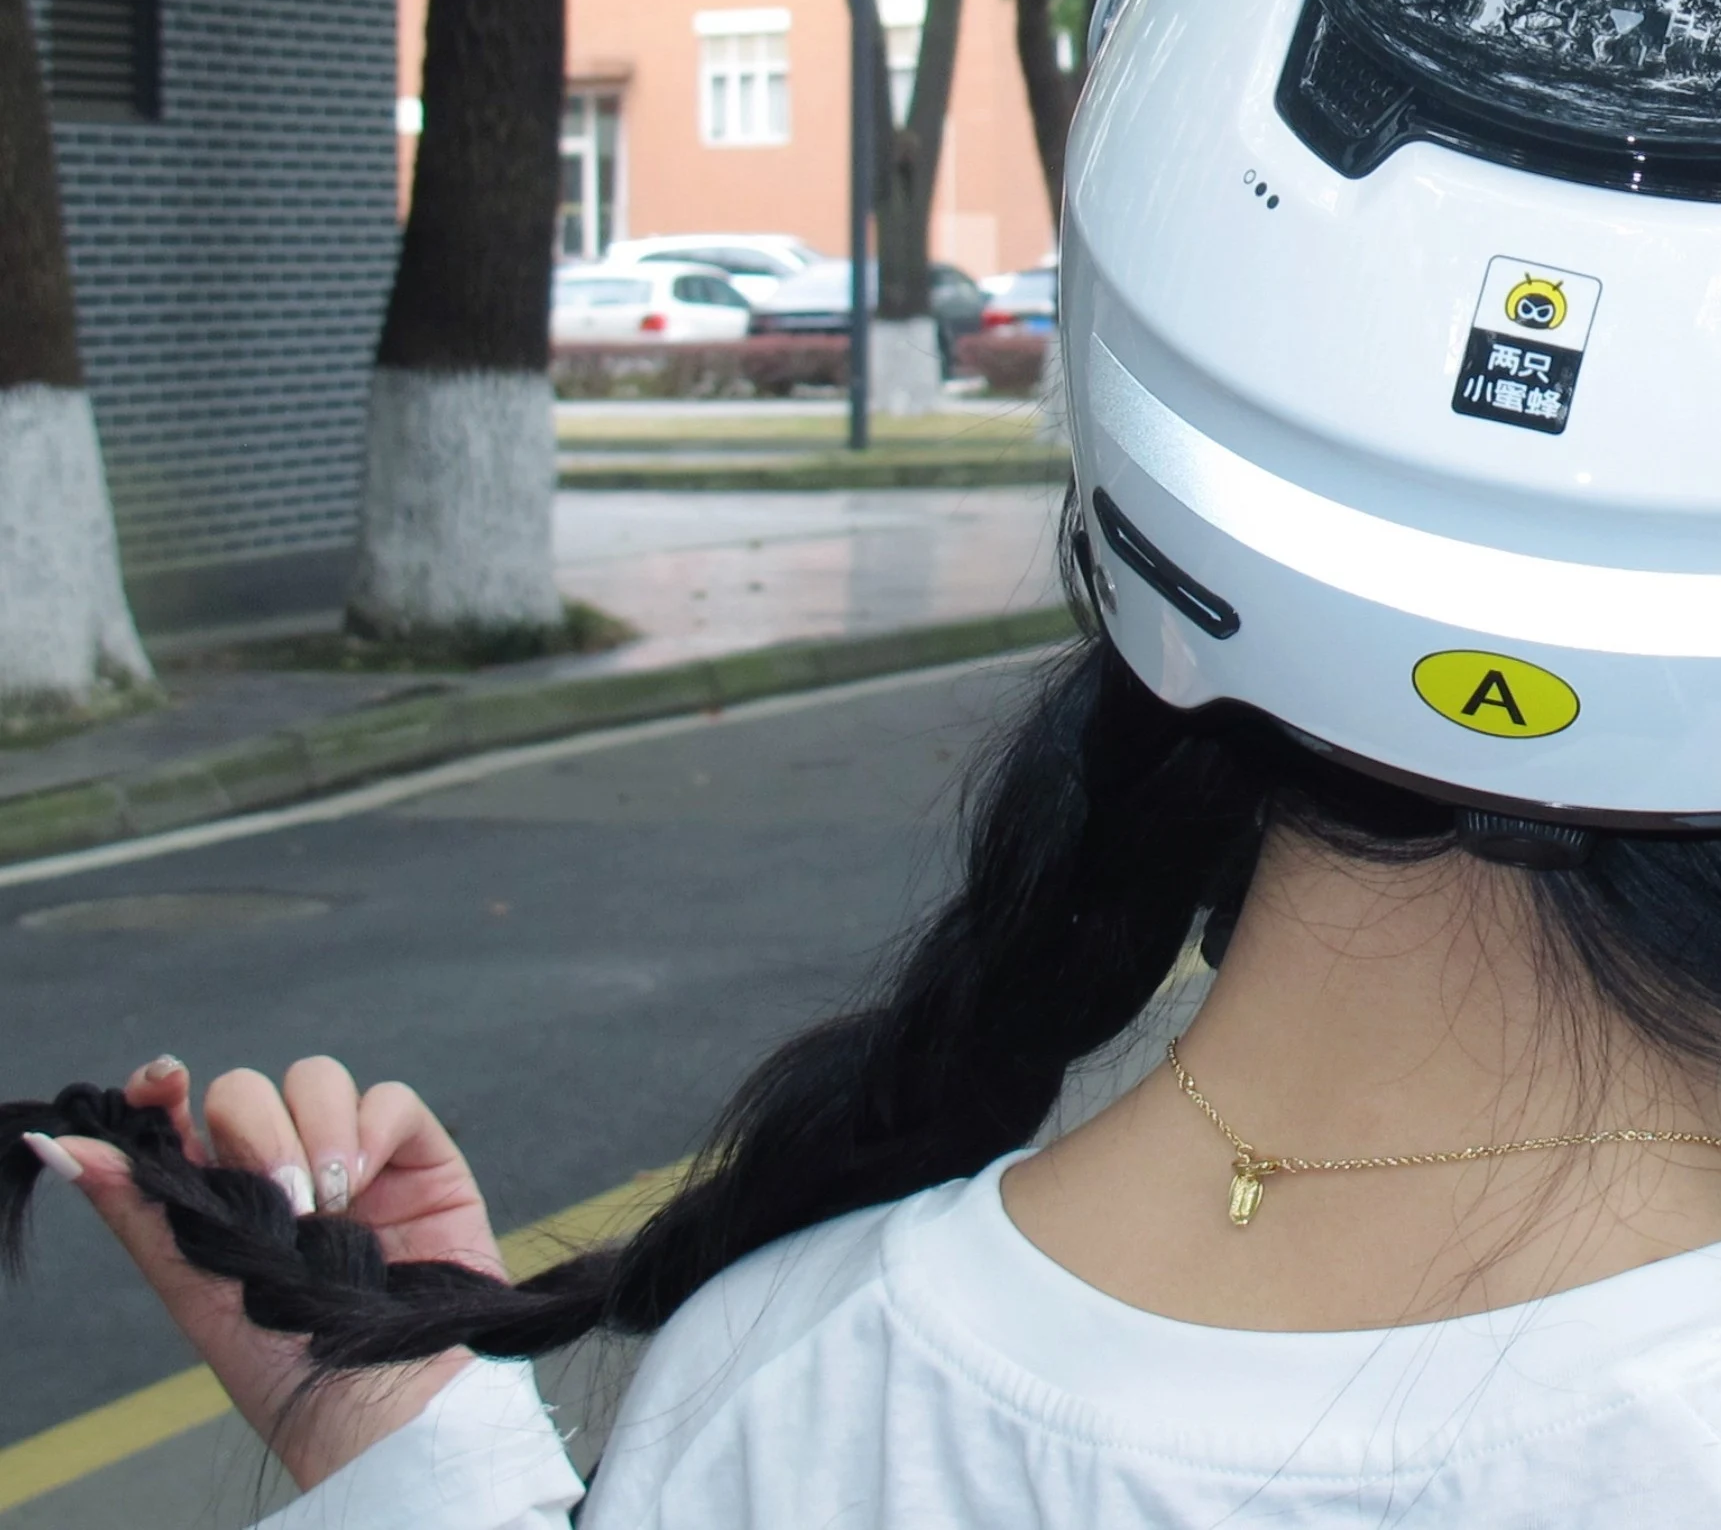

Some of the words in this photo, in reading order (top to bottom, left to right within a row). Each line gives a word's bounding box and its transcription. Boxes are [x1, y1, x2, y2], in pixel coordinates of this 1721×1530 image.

[1487, 342, 1552, 384] 两只
[1463, 374, 1563, 419] 小蜜蜂
[1461, 669, 1527, 727] A
